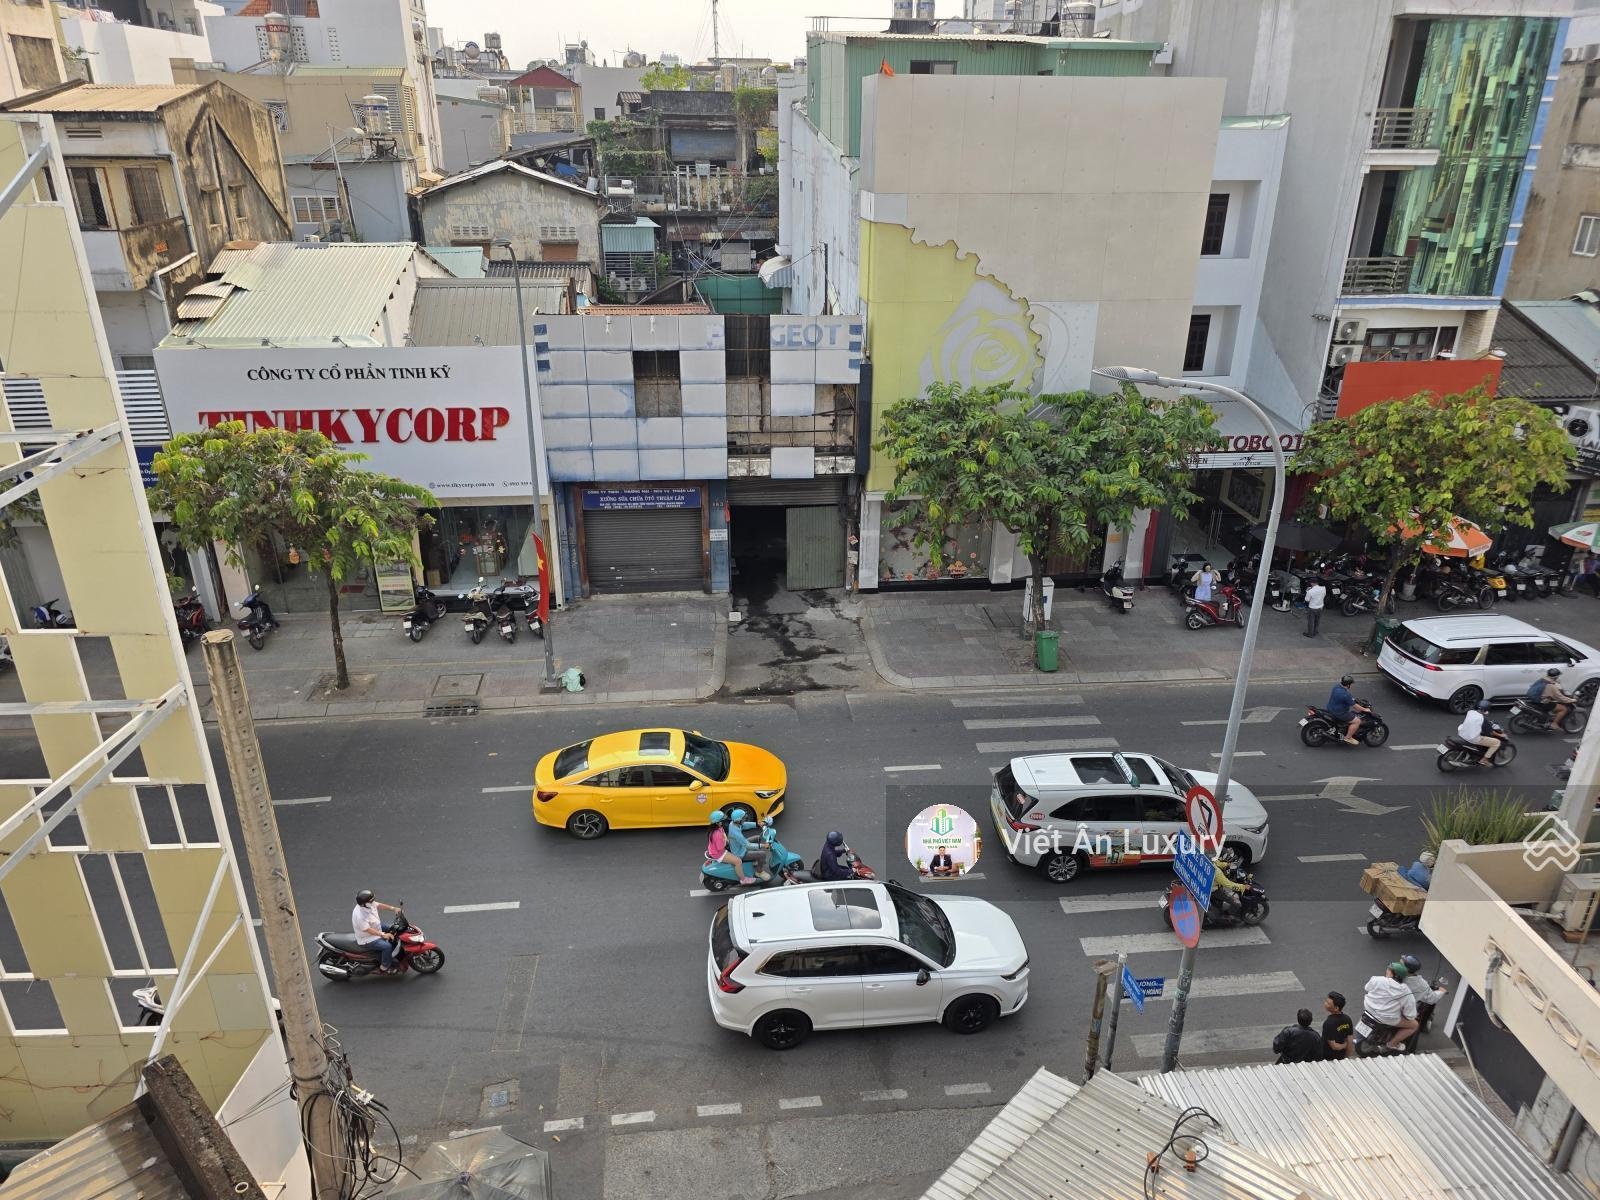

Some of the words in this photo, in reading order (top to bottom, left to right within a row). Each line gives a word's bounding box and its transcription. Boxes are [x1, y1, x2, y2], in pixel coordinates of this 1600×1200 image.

[247, 365, 292, 381] CÔNG
[295, 368, 315, 380] TY
[319, 363, 341, 380] CỔ
[345, 362, 386, 380] PHẦN
[389, 367, 426, 379] TINH
[430, 364, 451, 379] KỸ
